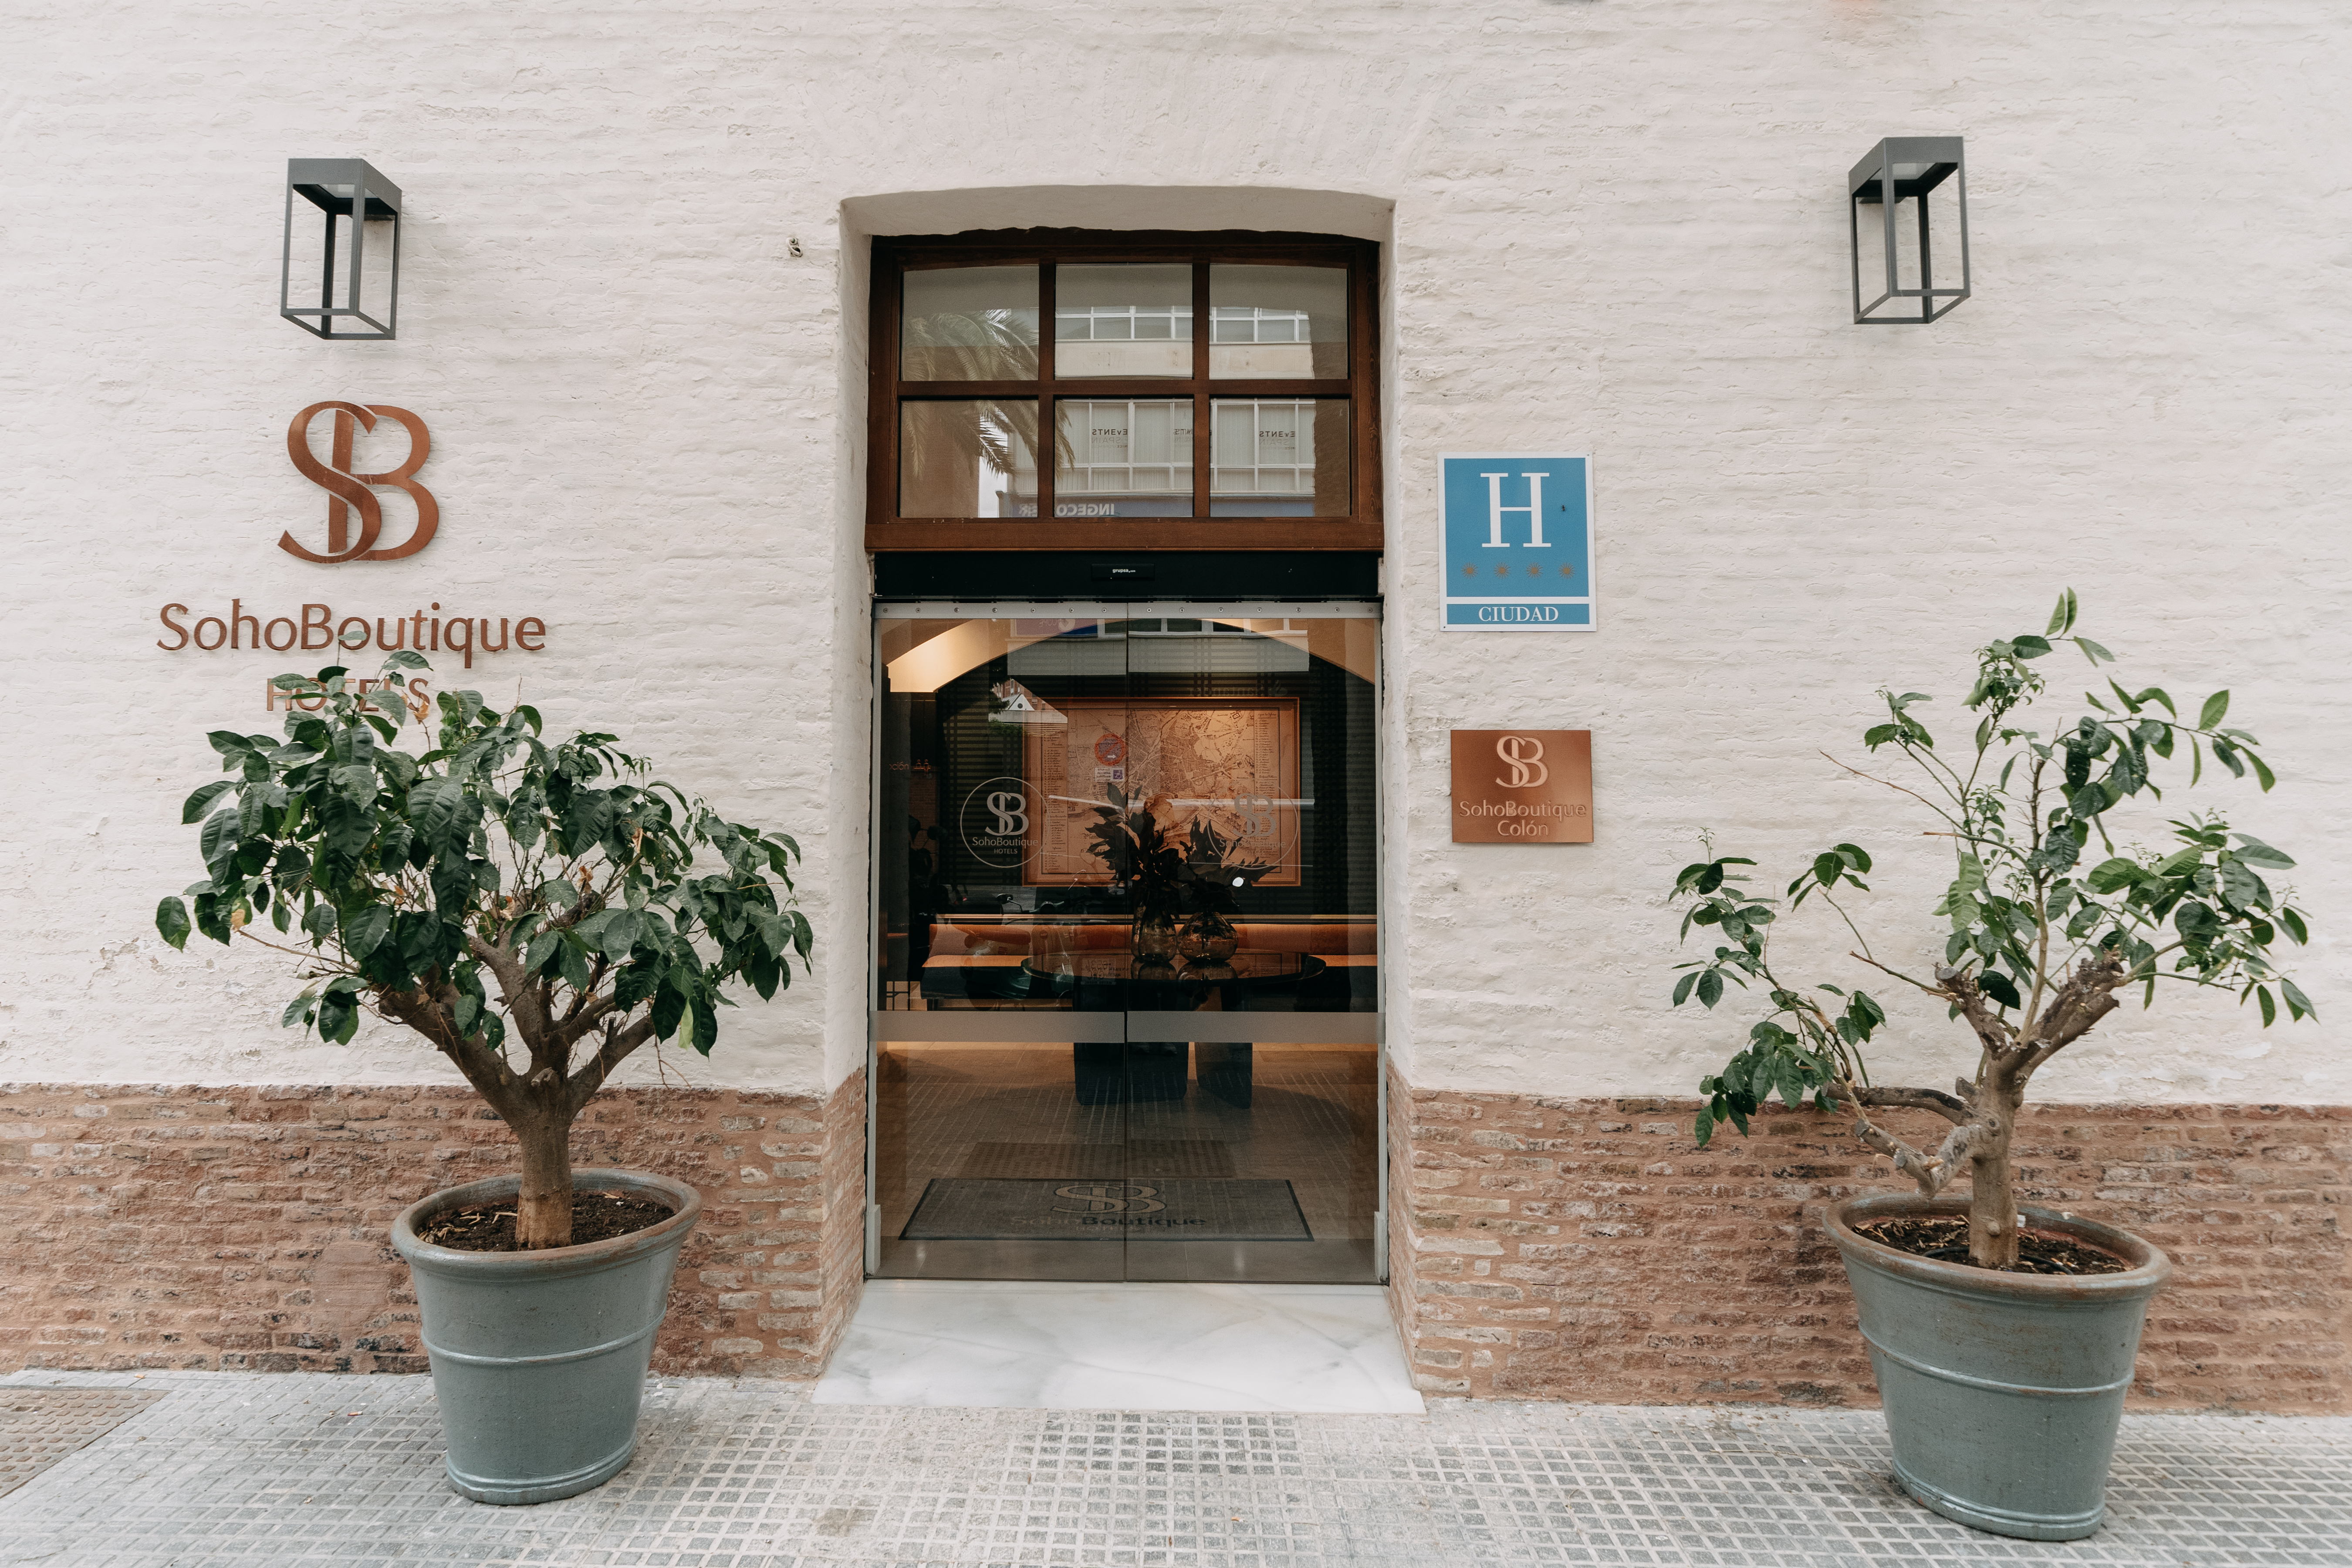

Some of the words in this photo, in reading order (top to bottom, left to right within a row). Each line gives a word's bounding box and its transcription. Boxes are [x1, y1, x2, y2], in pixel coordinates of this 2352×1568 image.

[277, 400, 439, 564] SB
[1480, 473, 1551, 547] H
[1478, 606, 1559, 622] CIUDAD
[156, 598, 547, 669] SohoBoutique
[1495, 735, 1549, 788] SB
[985, 791, 1029, 836] SB
[1233, 793, 1277, 838] SB
[1459, 800, 1587, 822] SohoBoutique
[1497, 820, 1549, 837] Colón
[972, 836, 1038, 849] SohoBoutique
[1219, 838, 1286, 851] SohoBoutique
[1050, 1184, 1168, 1214] SB
